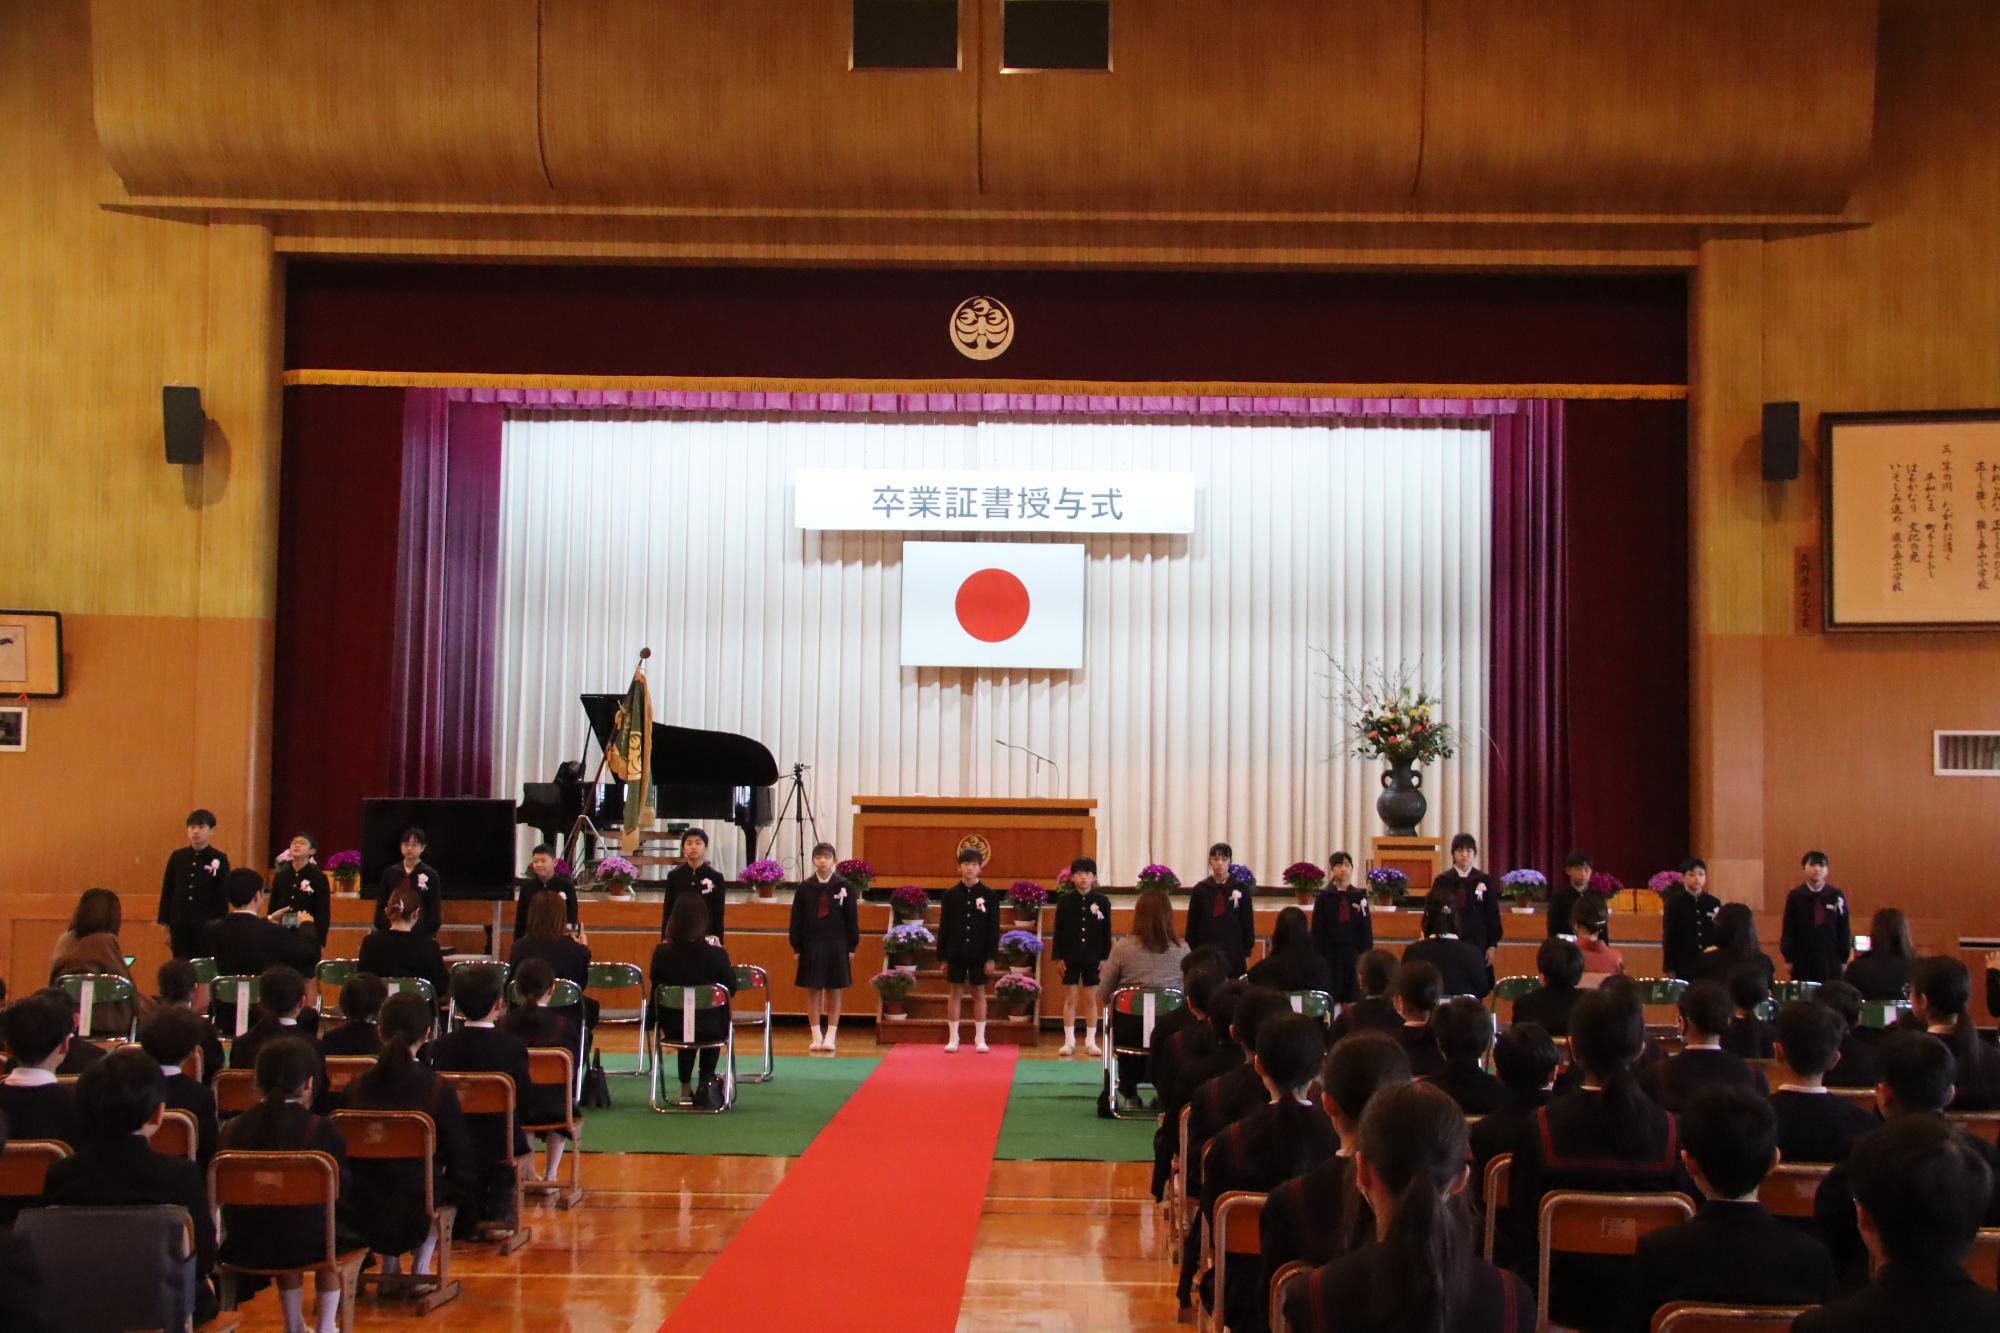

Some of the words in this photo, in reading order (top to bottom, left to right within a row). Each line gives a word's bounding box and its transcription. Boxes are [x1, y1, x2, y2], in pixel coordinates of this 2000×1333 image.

[872, 485, 1124, 521] 卒業証書授与式
